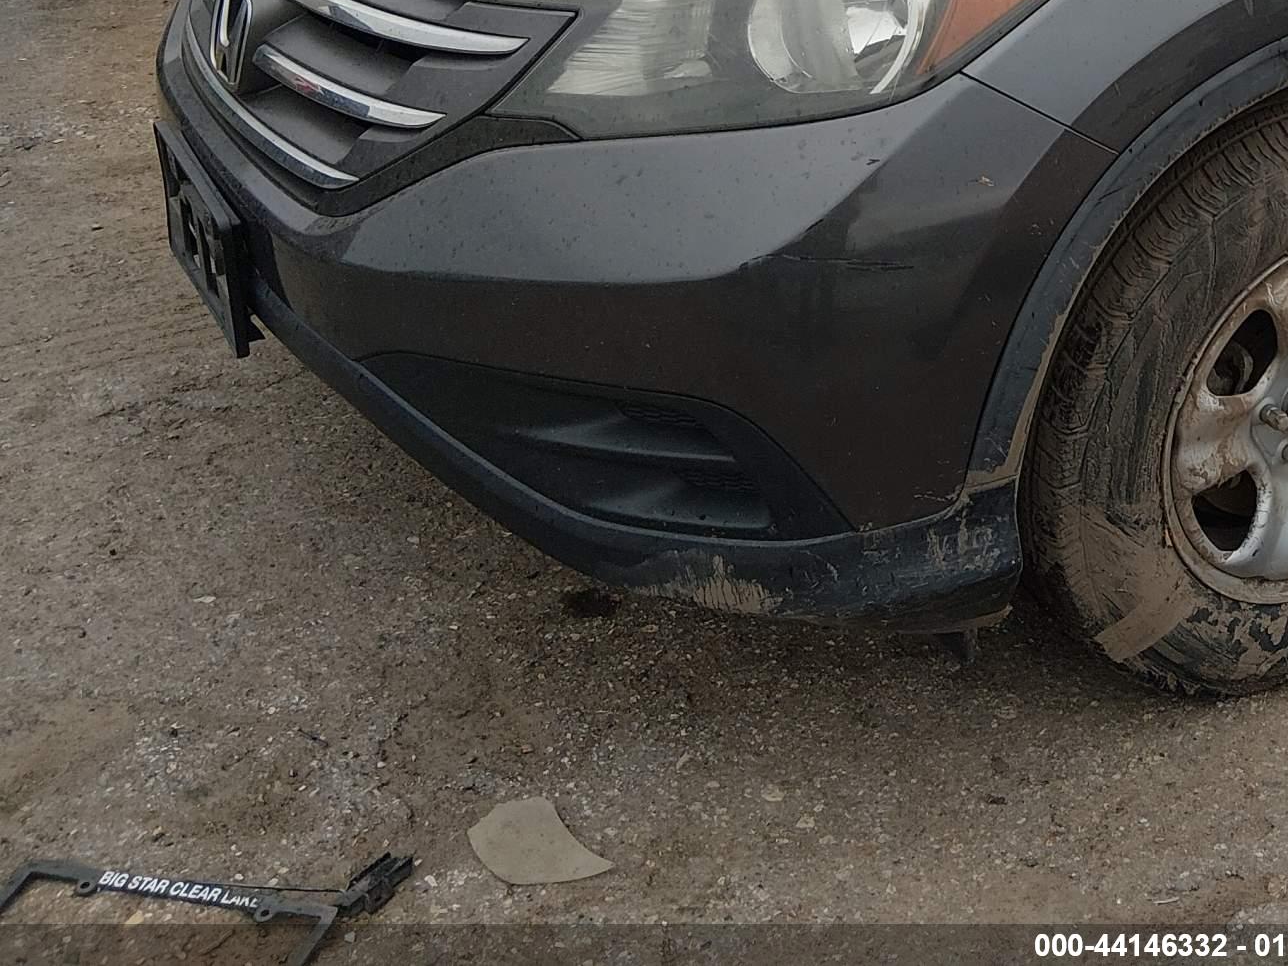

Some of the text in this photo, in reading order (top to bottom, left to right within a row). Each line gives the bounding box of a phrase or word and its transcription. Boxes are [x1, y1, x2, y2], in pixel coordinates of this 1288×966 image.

[99, 871, 128, 887] BIG
[128, 875, 169, 894] STAR
[170, 882, 222, 902] CLEAR
